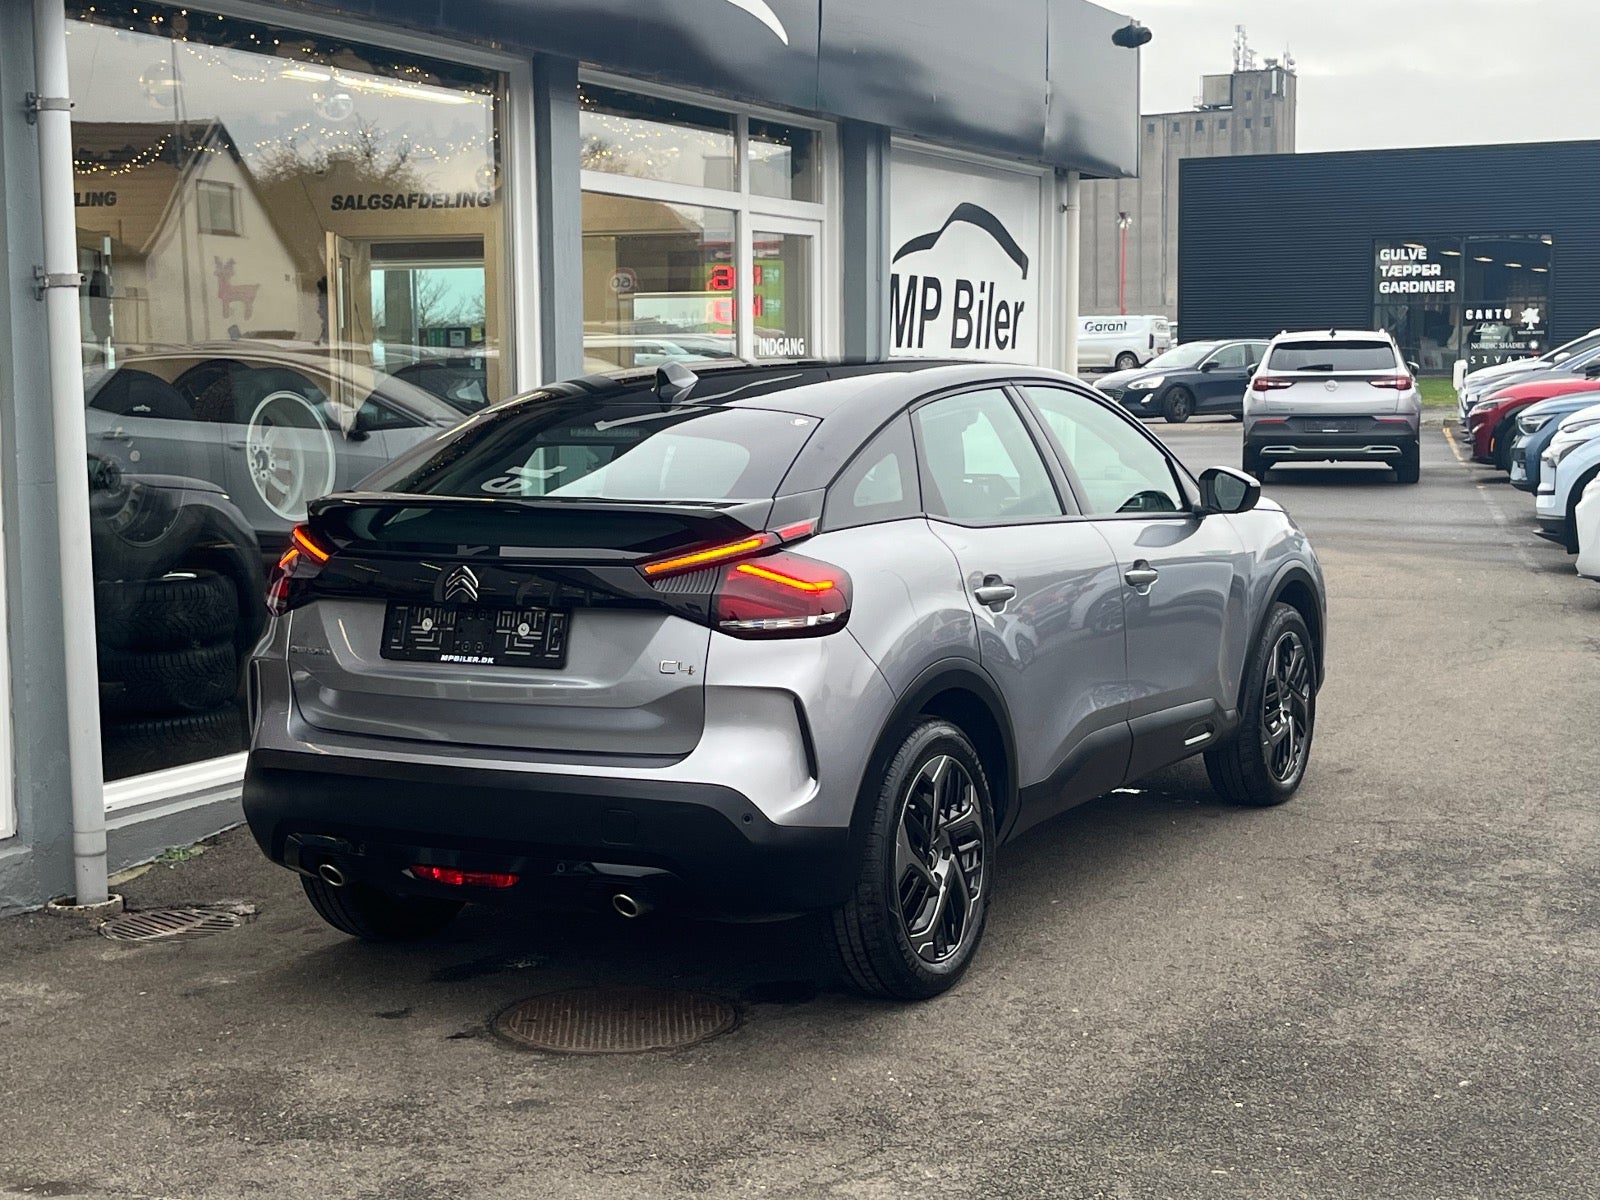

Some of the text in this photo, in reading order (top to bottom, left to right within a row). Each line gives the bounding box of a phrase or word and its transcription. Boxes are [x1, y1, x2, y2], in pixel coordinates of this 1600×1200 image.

[74, 191, 117, 207] LING
[331, 192, 491, 211] SALGSAFDELING
[1380, 248, 1427, 260] GULVE
[1380, 264, 1442, 277] TÆPPER
[1379, 280, 1456, 294] GARDINER
[890, 273, 1025, 351] MP Biler
[1465, 308, 1512, 320] CANTO
[1084, 321, 1128, 332] Garant
[759, 338, 805, 355] INDGANG
[659, 660, 696, 675] C4
